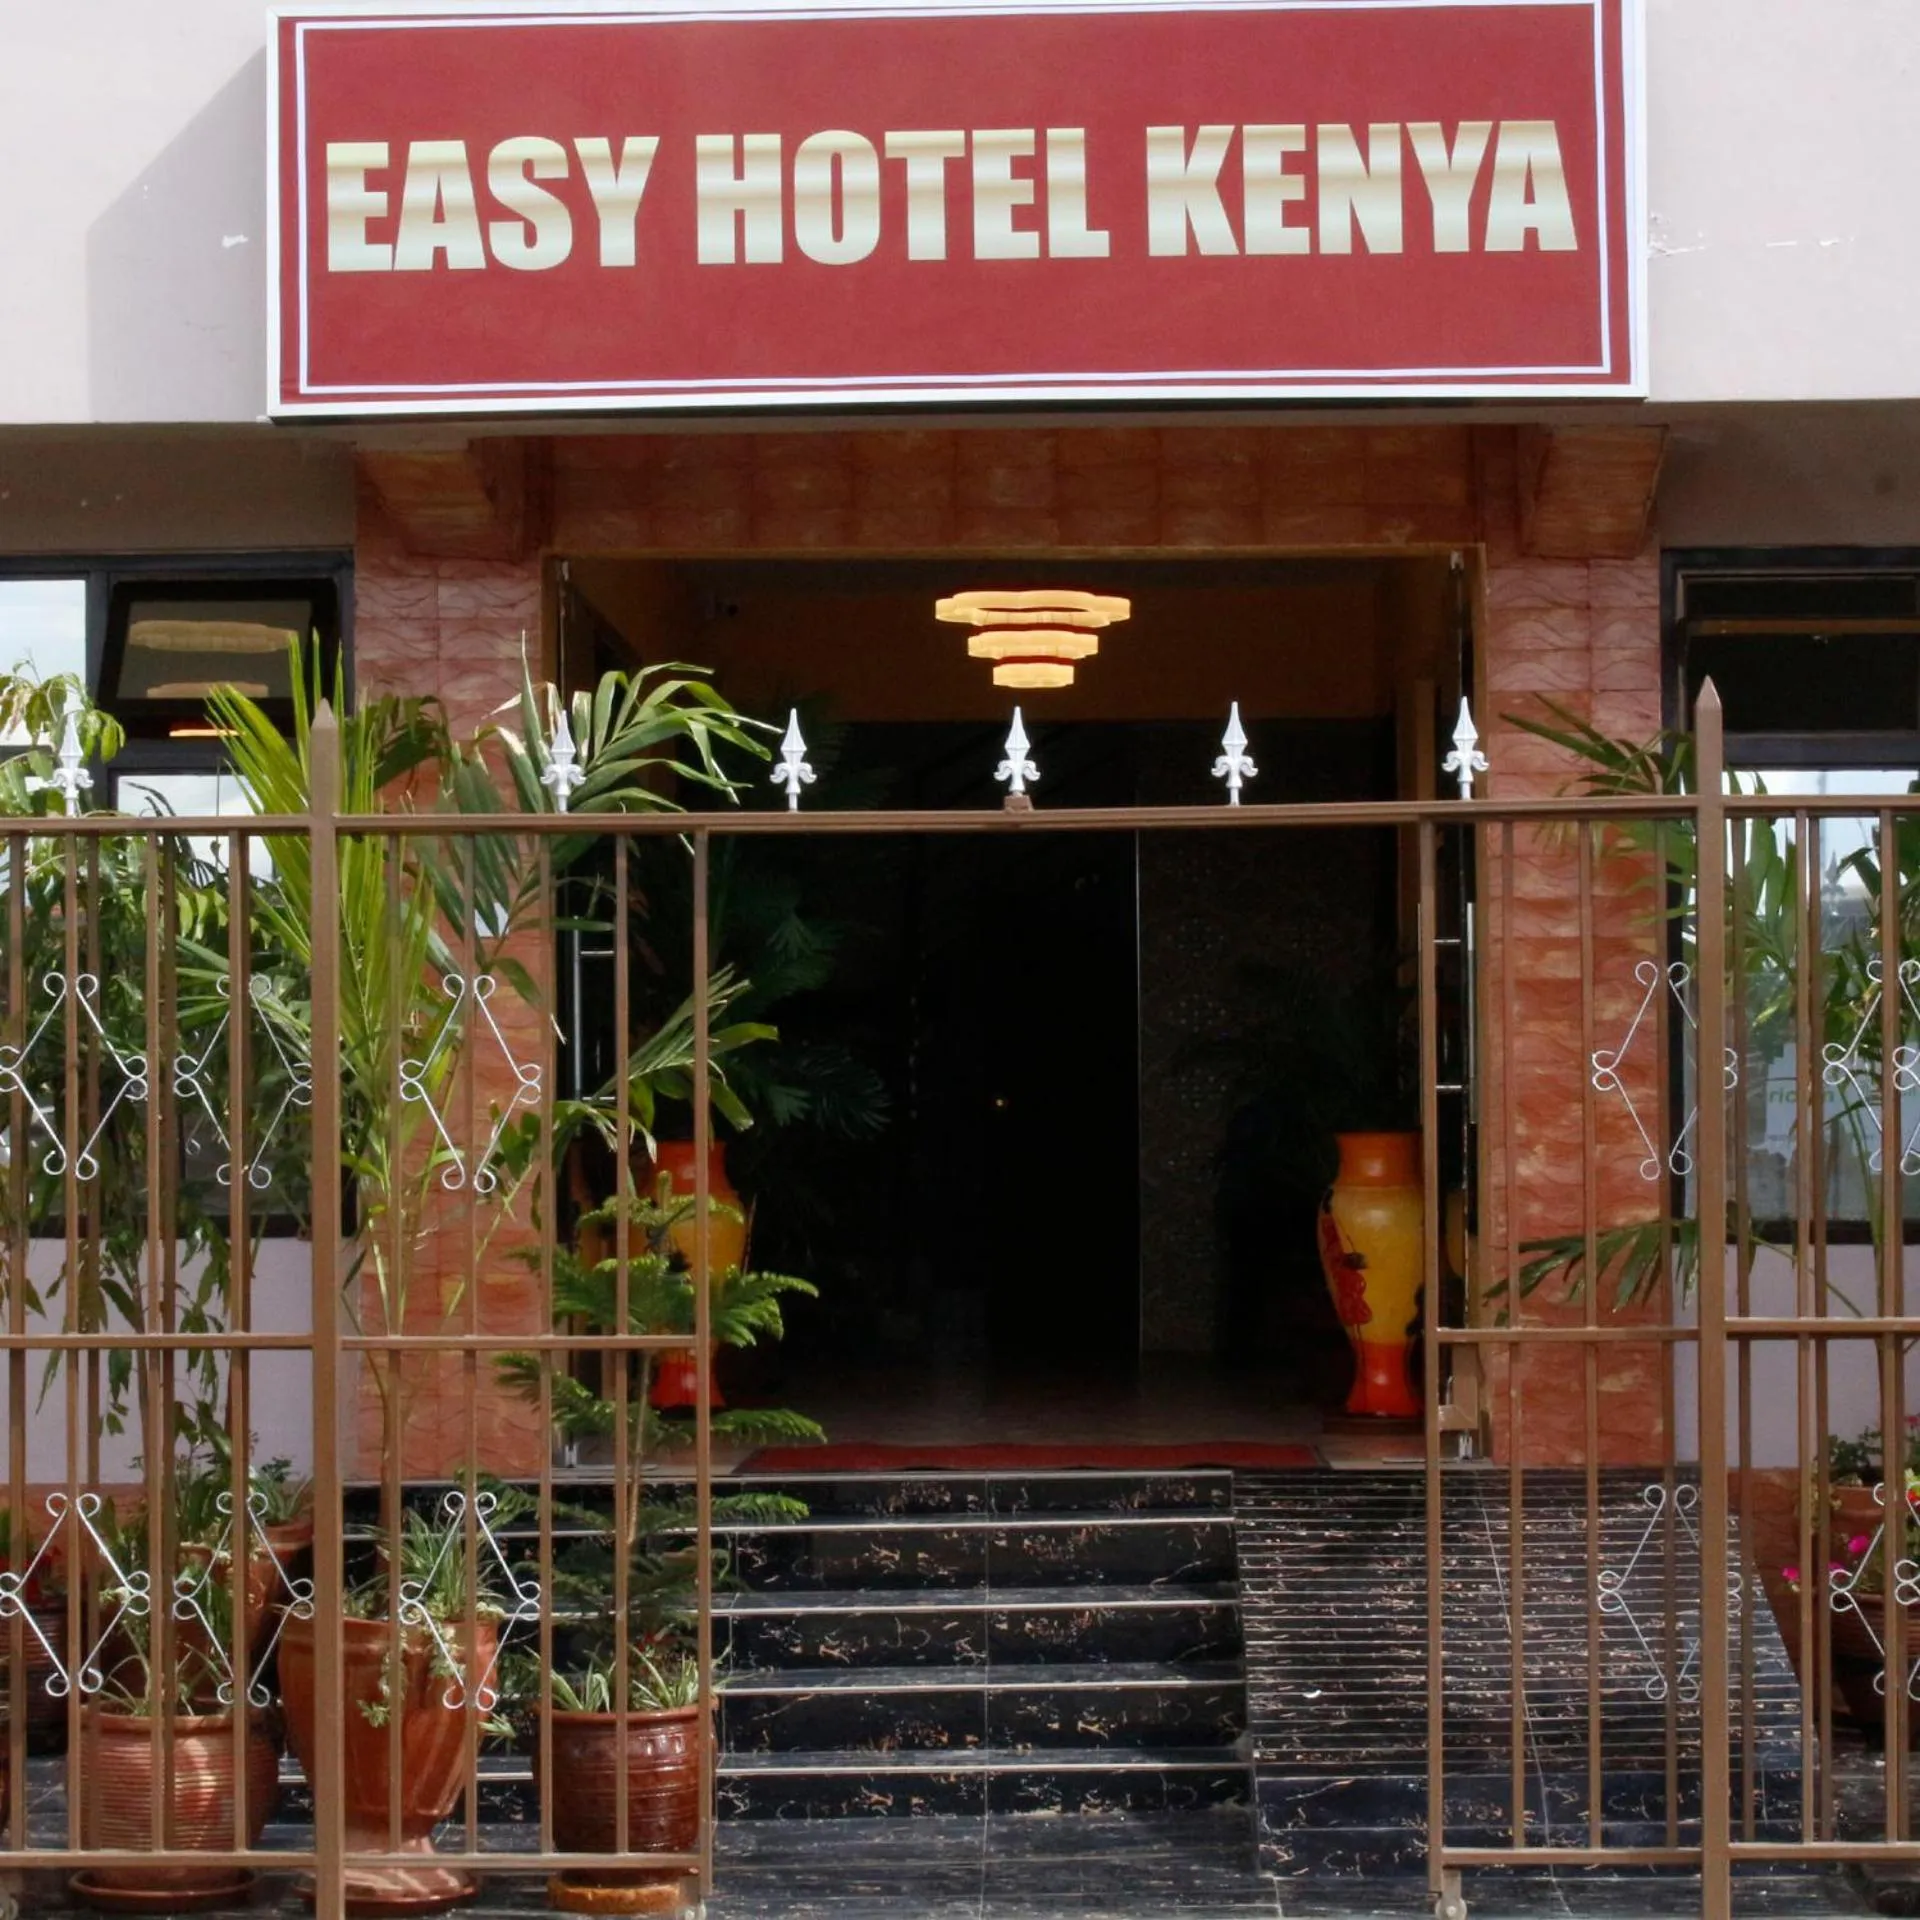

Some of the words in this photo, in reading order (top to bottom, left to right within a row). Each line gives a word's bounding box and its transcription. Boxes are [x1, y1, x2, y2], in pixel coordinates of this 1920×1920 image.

[324, 133, 661, 274] EASY
[694, 127, 1112, 267] HOTEL
[1145, 118, 1580, 259] KENYA
